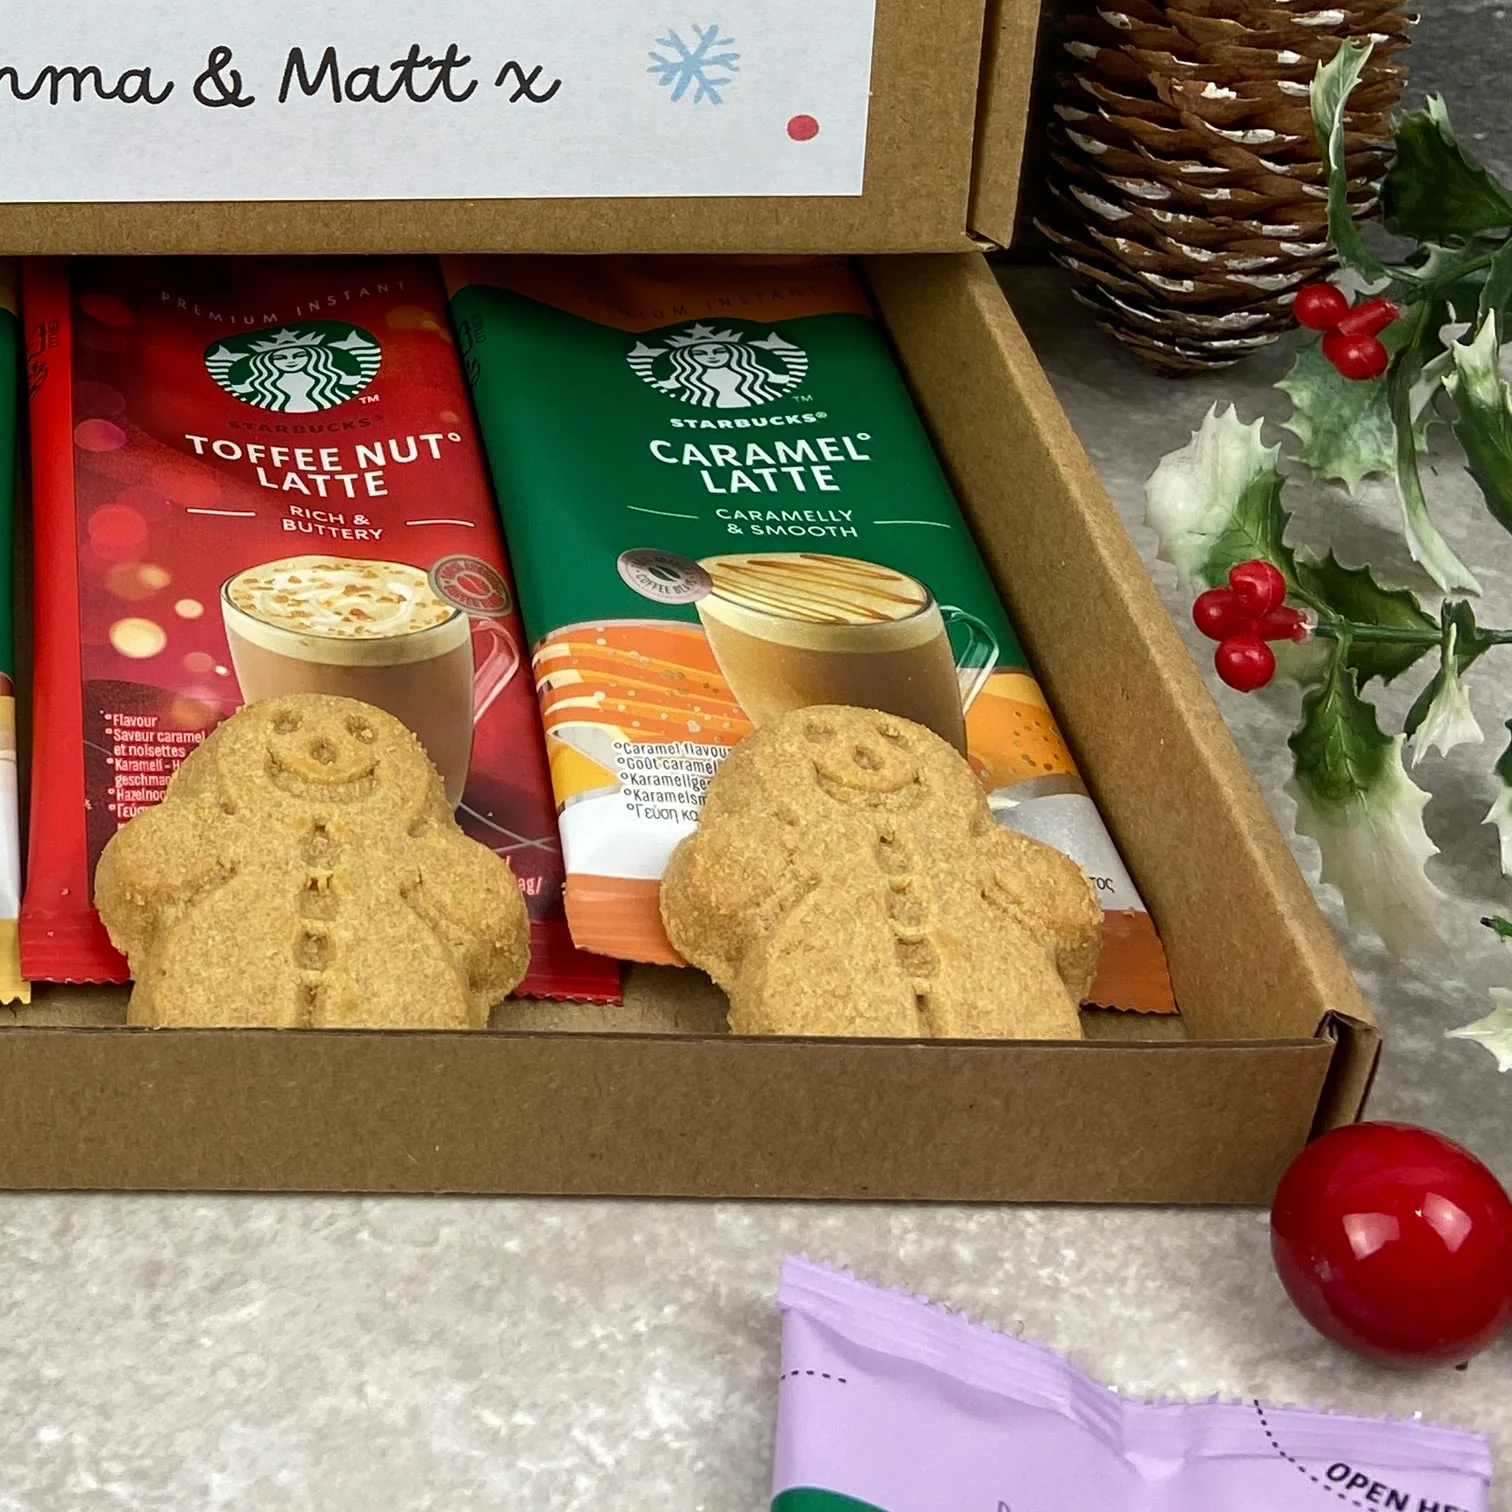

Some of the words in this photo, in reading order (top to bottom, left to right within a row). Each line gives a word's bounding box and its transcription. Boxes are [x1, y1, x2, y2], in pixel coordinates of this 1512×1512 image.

[192, 46, 255, 109] &
[278, 42, 479, 107] Matt
[494, 59, 562, 105] x
[160, 291, 279, 326] PREMIUM
[295, 280, 407, 317] INSTANT
[184, 433, 342, 473] TOFFEE
[255, 465, 390, 499] LATTE
[699, 464, 842, 495] LATTE
[289, 504, 347, 526] RICH
[352, 512, 371, 527] &
[714, 507, 854, 524] CARAMELLY
[282, 518, 384, 542] BUTTERY
[726, 522, 744, 535] &
[750, 523, 859, 539] SMOOTH
[156, 730, 207, 744] caramel
[113, 743, 129, 757] et
[128, 744, 187, 759] noisettes
[683, 742, 733, 760] flavou
[662, 758, 719, 776] caramel
[1325, 1461, 1410, 1512] OPEN
